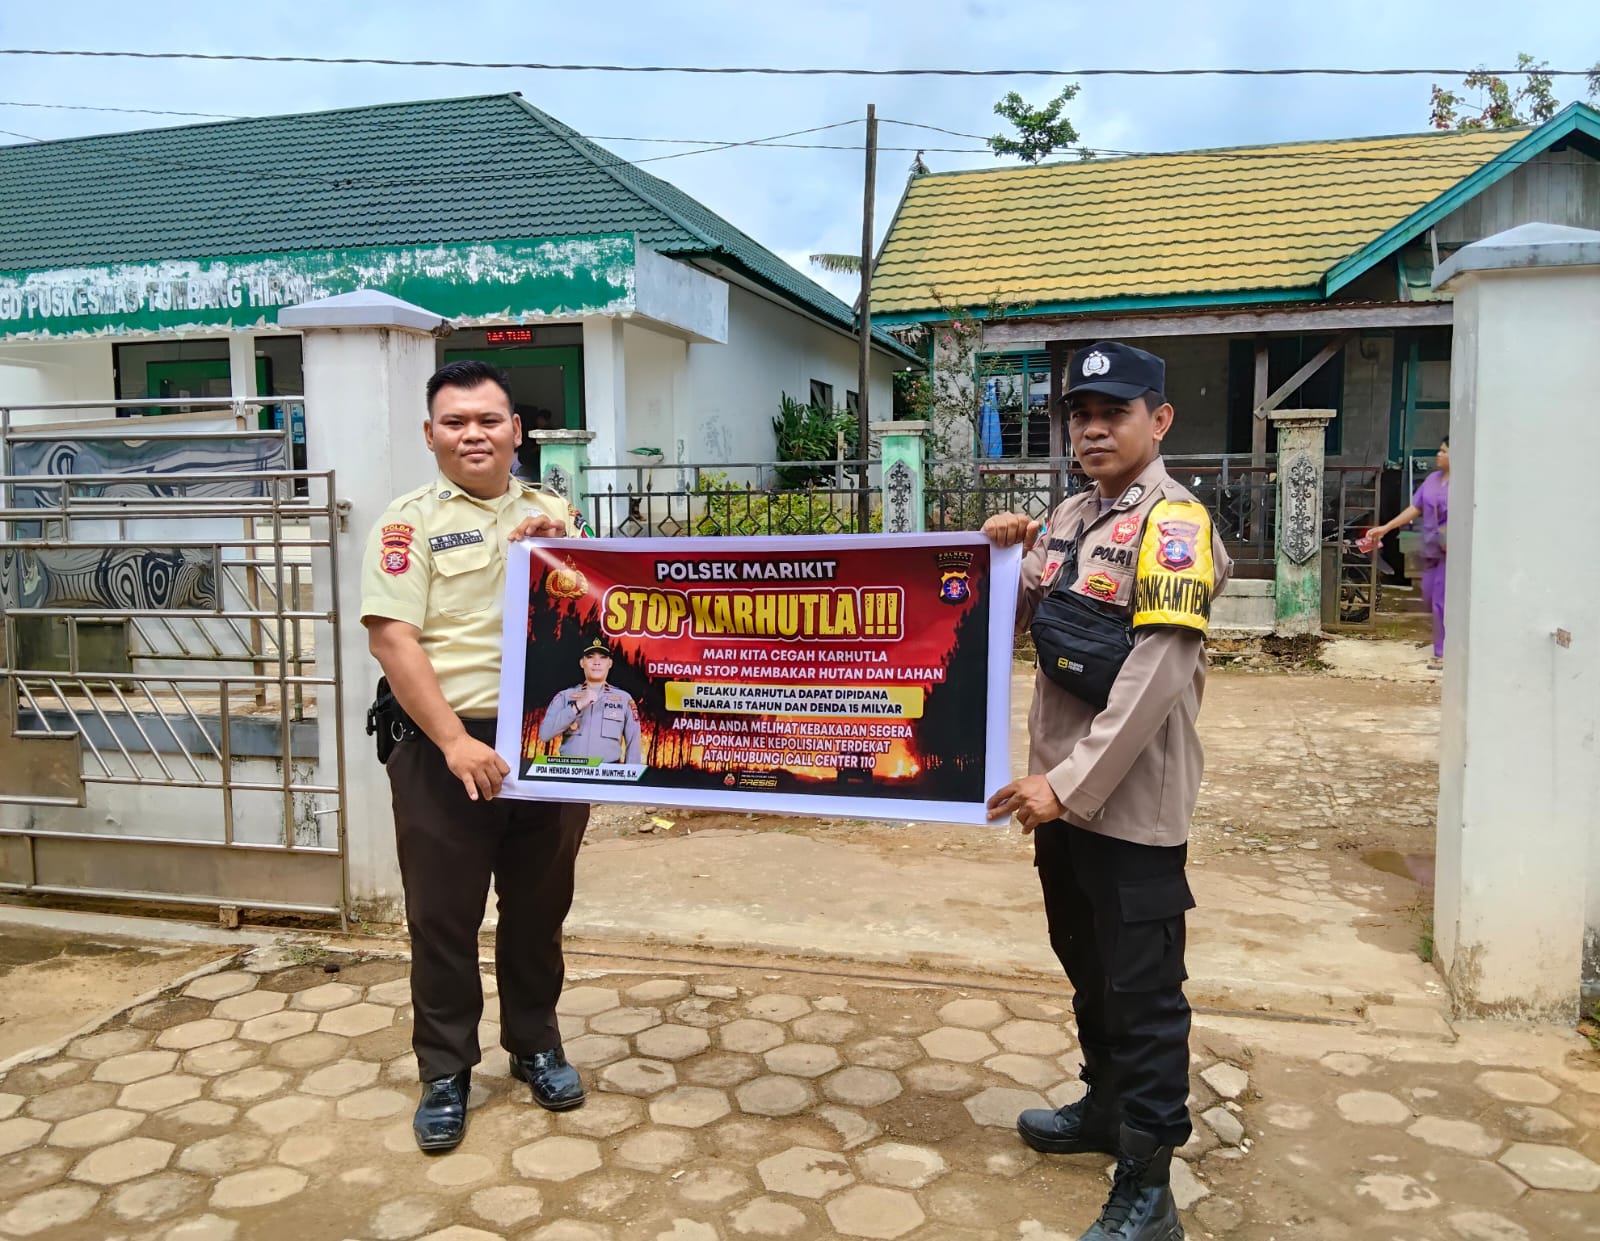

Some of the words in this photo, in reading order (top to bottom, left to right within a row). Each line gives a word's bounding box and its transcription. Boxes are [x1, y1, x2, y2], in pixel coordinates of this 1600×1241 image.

[27, 282, 139, 318] PUSKESMAS
[146, 277, 242, 311] TUMBANG
[1091, 544, 1133, 567] POLRI
[657, 562, 738, 580] POLSEK
[743, 561, 836, 580] MARIKIT
[606, 590, 688, 633] STOP
[692, 593, 857, 636] KARHUTLA
[864, 592, 898, 635] !!!
[703, 648, 737, 660] MARI
[740, 649, 768, 661] KITA
[770, 650, 815, 662] CEGAH
[818, 650, 888, 662] KARHUTLA
[648, 663, 702, 676] DENGAN
[704, 665, 739, 677] STOP
[740, 666, 816, 679] MEMBAKAR
[819, 667, 863, 680] HUTAN
[866, 668, 894, 680] DAN
[897, 668, 943, 680] LAHAN
[696, 686, 737, 697] PELAKU
[740, 687, 796, 698] KARHUTLA
[798, 689, 832, 699] DAPAT
[835, 689, 888, 700] DIPIDANA
[683, 698, 730, 710] PENJARA
[733, 700, 743, 710] 15
[745, 701, 782, 711] TAHUN
[785, 702, 808, 712] DAN
[810, 702, 847, 713] DENDA
[849, 703, 859, 713] 15
[861, 703, 902, 714] MILYAR
[672, 718, 717, 731] APABILA
[719, 720, 749, 733] ANDA
[751, 721, 798, 734] MELIHAT
[800, 723, 867, 737] KEBAKARAN
[869, 725, 913, 738] SEGERA
[692, 734, 751, 748] LAPORKAN
[753, 736, 767, 749] KE
[768, 737, 832, 751] KEPOLISIAN
[835, 739, 890, 753] TERDEKAT
[703, 749, 731, 763] ATAU
[733, 750, 783, 765] HUBUNGI
[785, 752, 812, 766] CALL
[815, 754, 858, 768] CENTER
[860, 756, 876, 769] 110
